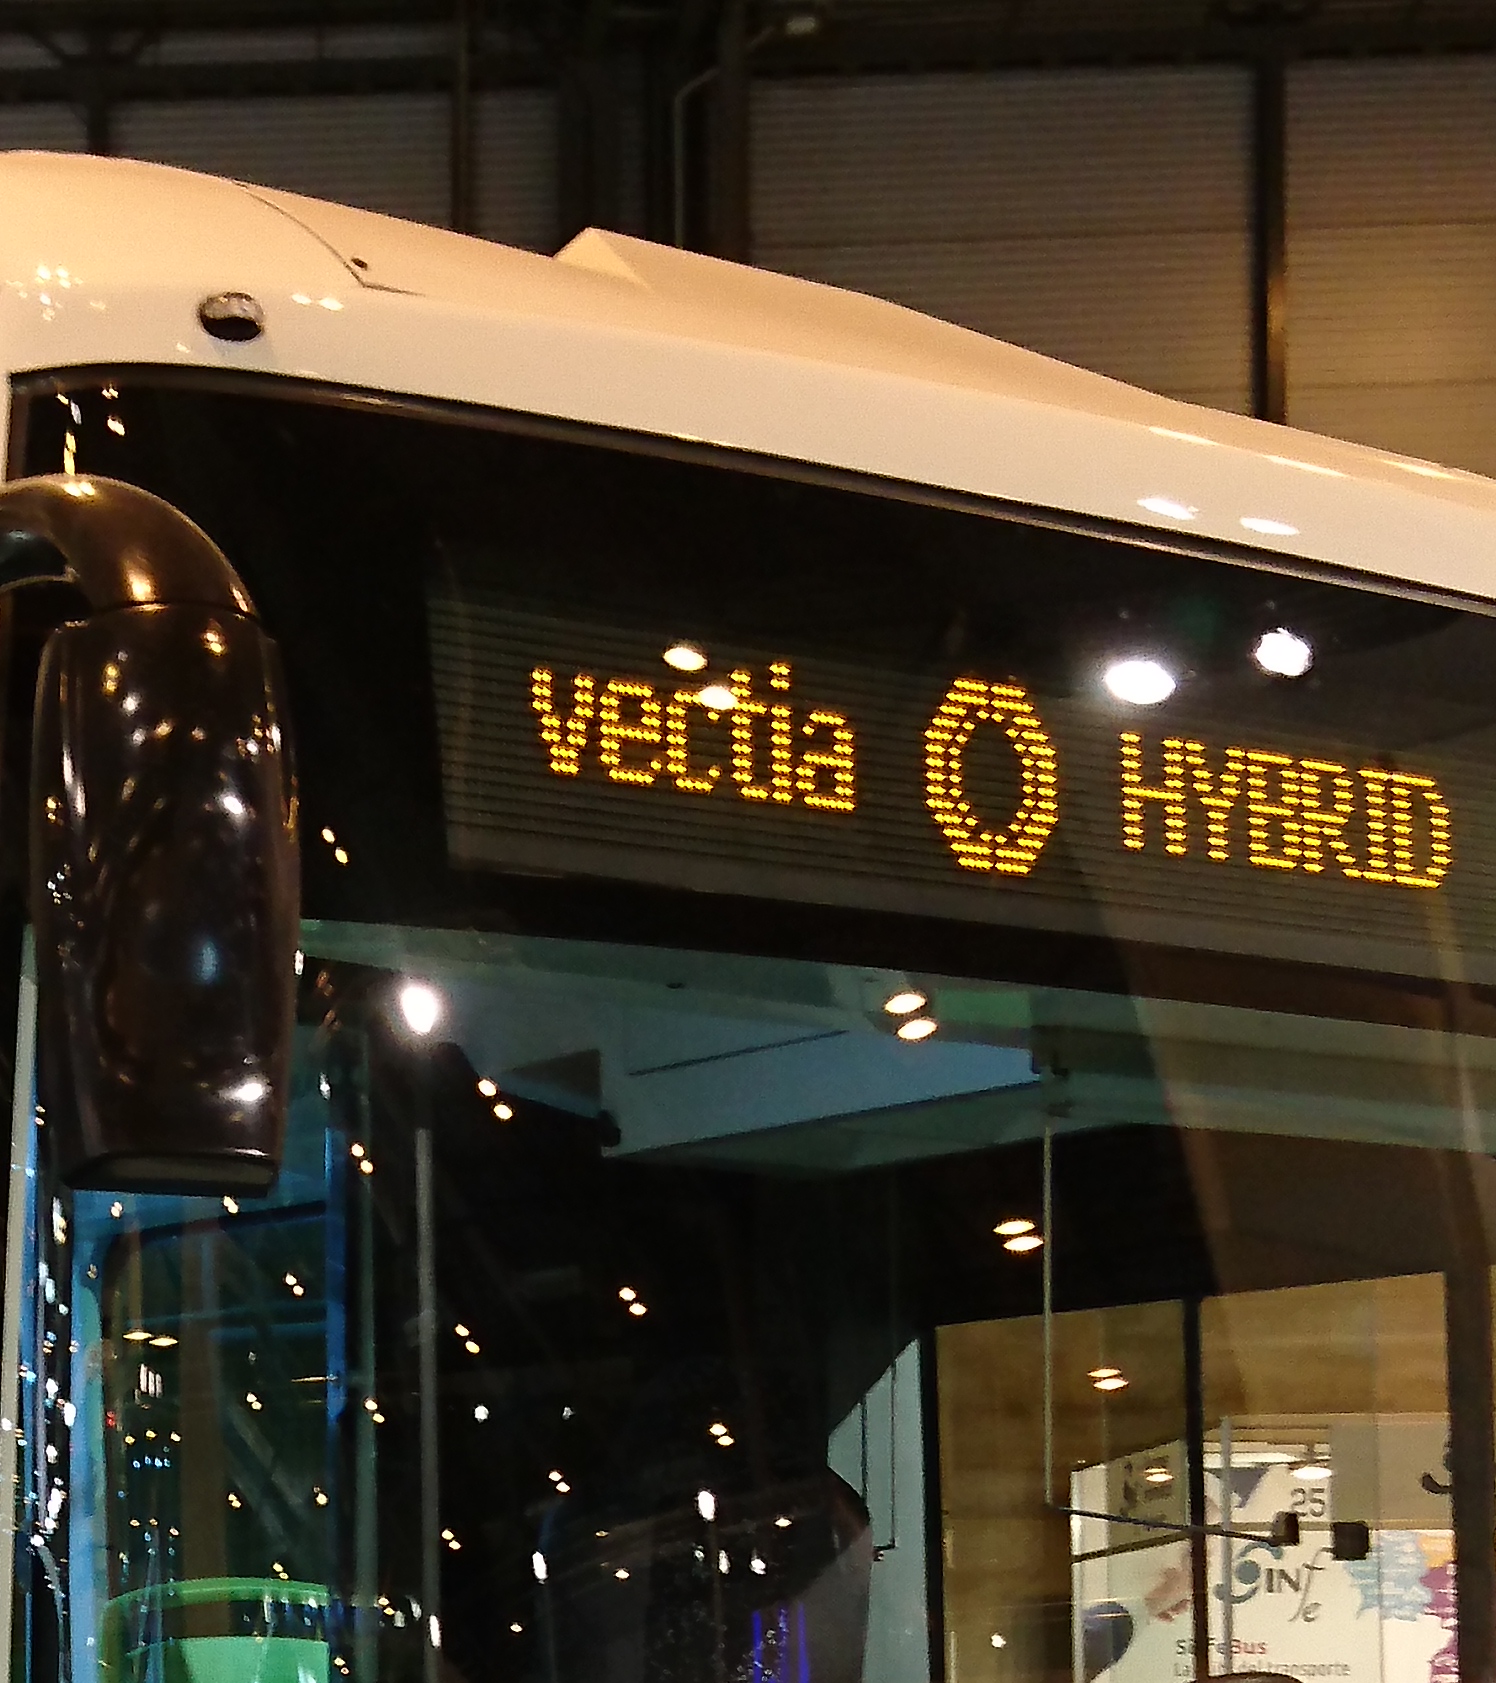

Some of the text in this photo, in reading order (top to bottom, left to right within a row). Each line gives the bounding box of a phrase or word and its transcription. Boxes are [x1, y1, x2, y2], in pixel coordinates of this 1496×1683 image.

[529, 660, 1454, 890] vectia HYBRID
[1290, 1487, 1326, 1517] 25
